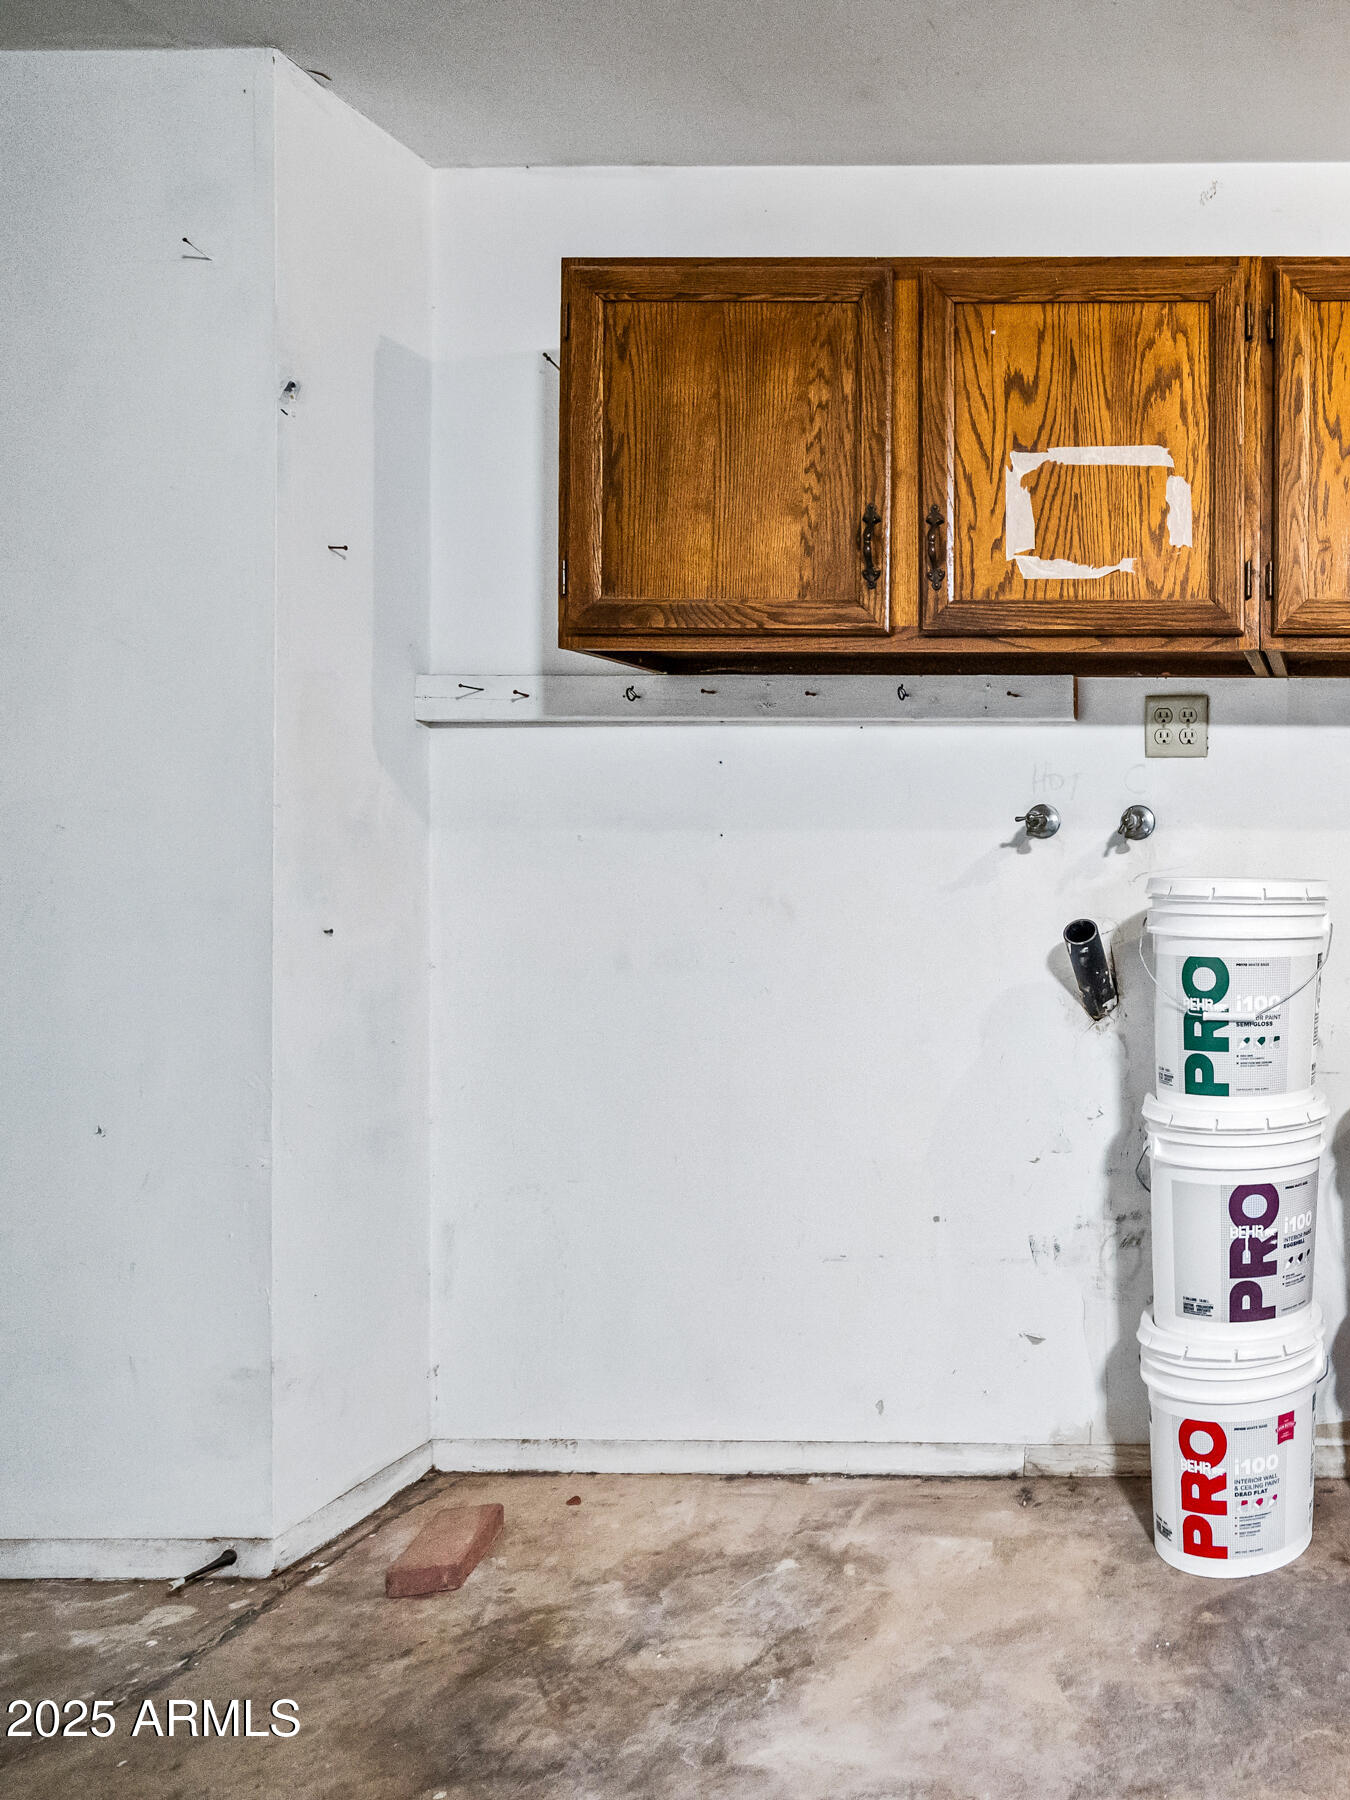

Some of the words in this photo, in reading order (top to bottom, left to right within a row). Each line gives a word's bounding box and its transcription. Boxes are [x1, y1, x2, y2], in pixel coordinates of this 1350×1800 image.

[1236, 994, 1281, 1012] i100
[1181, 956, 1230, 1096] PRO
[1284, 1210, 1312, 1234] i100
[1229, 1225, 1264, 1239] BEHR
[1228, 1182, 1280, 1323] PRO
[1181, 1457, 1212, 1474] BEHR
[1234, 1453, 1279, 1475] i100
[1233, 1476, 1263, 1485] INTERIOR
[1262, 1473, 1278, 1481] WALL
[1240, 1483, 1264, 1491] CEILING
[1264, 1478, 1281, 1487] PAINT
[1178, 1418, 1229, 1560] PRO
[1253, 1487, 1269, 1496] FLAT
